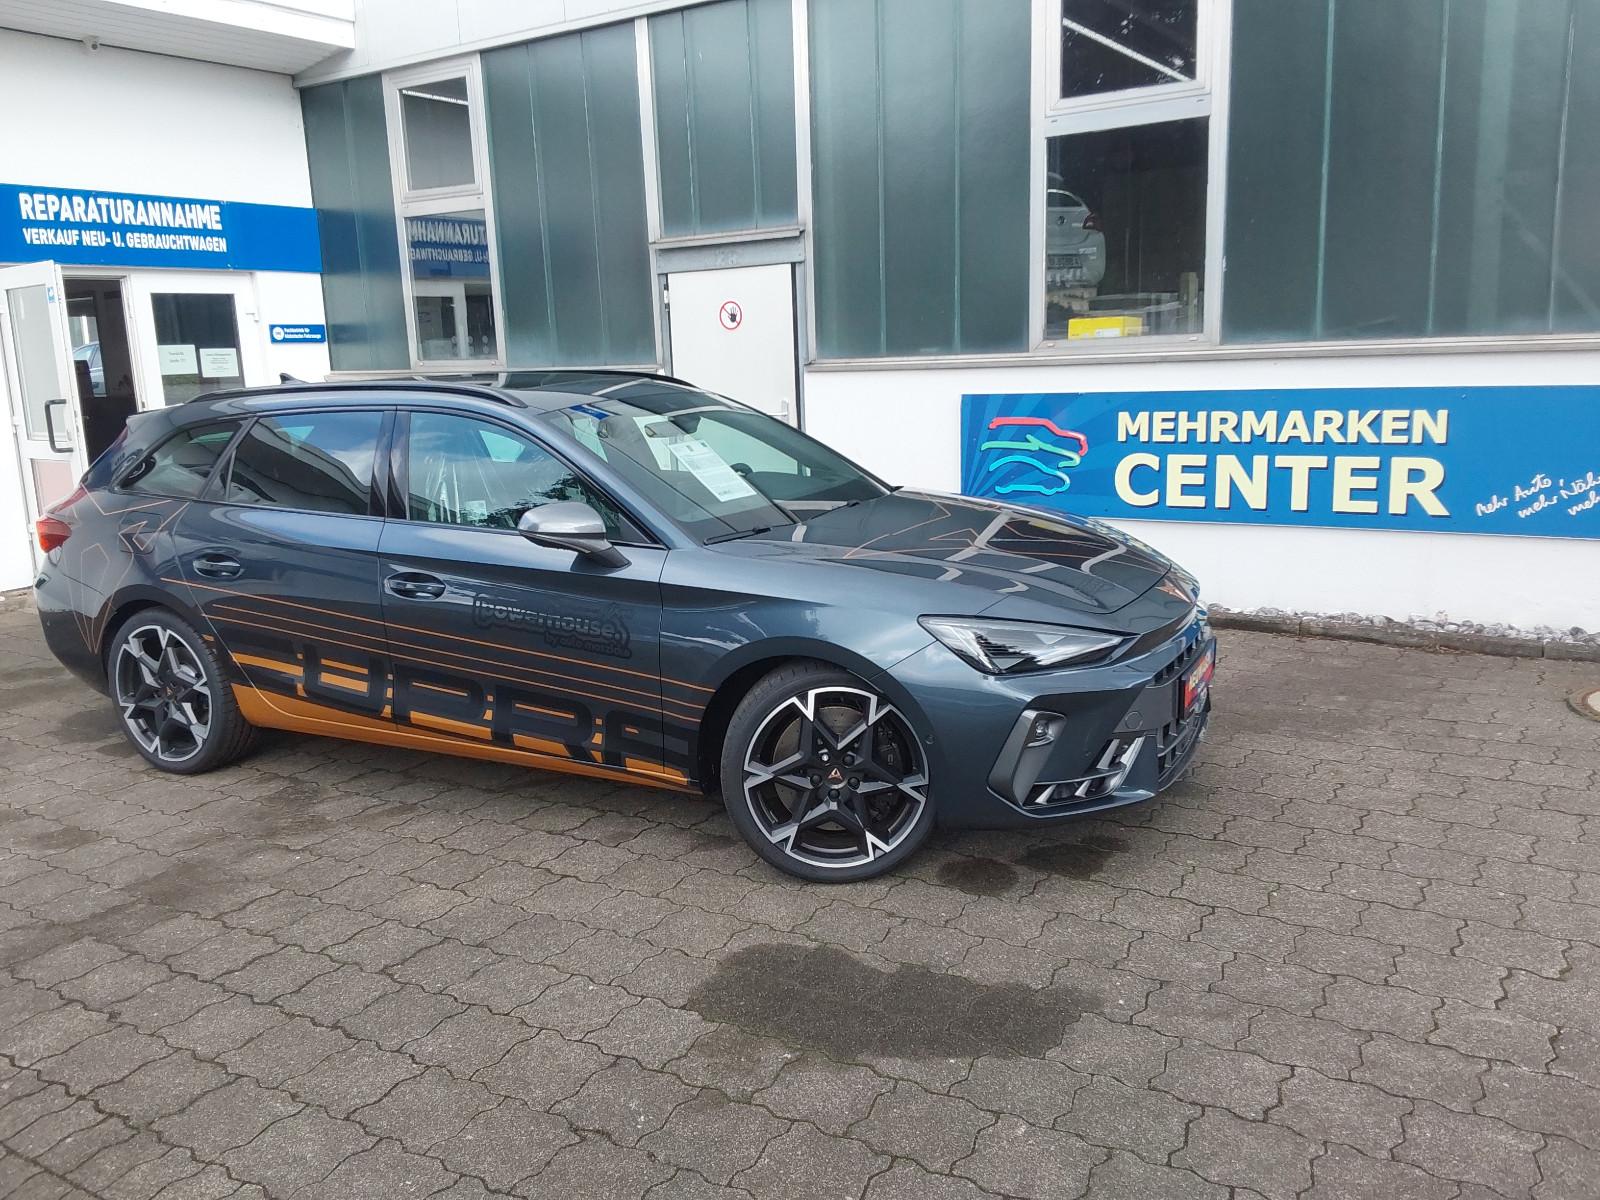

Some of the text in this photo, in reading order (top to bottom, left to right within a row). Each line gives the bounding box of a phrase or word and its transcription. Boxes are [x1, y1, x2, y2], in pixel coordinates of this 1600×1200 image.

[18, 192, 222, 230] REPARATURANNAHME
[23, 228, 227, 253] VERKAUF NEU- U. GEBRAUCHTWAGEN
[1117, 408, 1448, 445] MEHRMARKEN
[1114, 452, 1451, 517] CENTER
[1518, 471, 1600, 518] mehr Näh
[1567, 490, 1600, 515] meh
